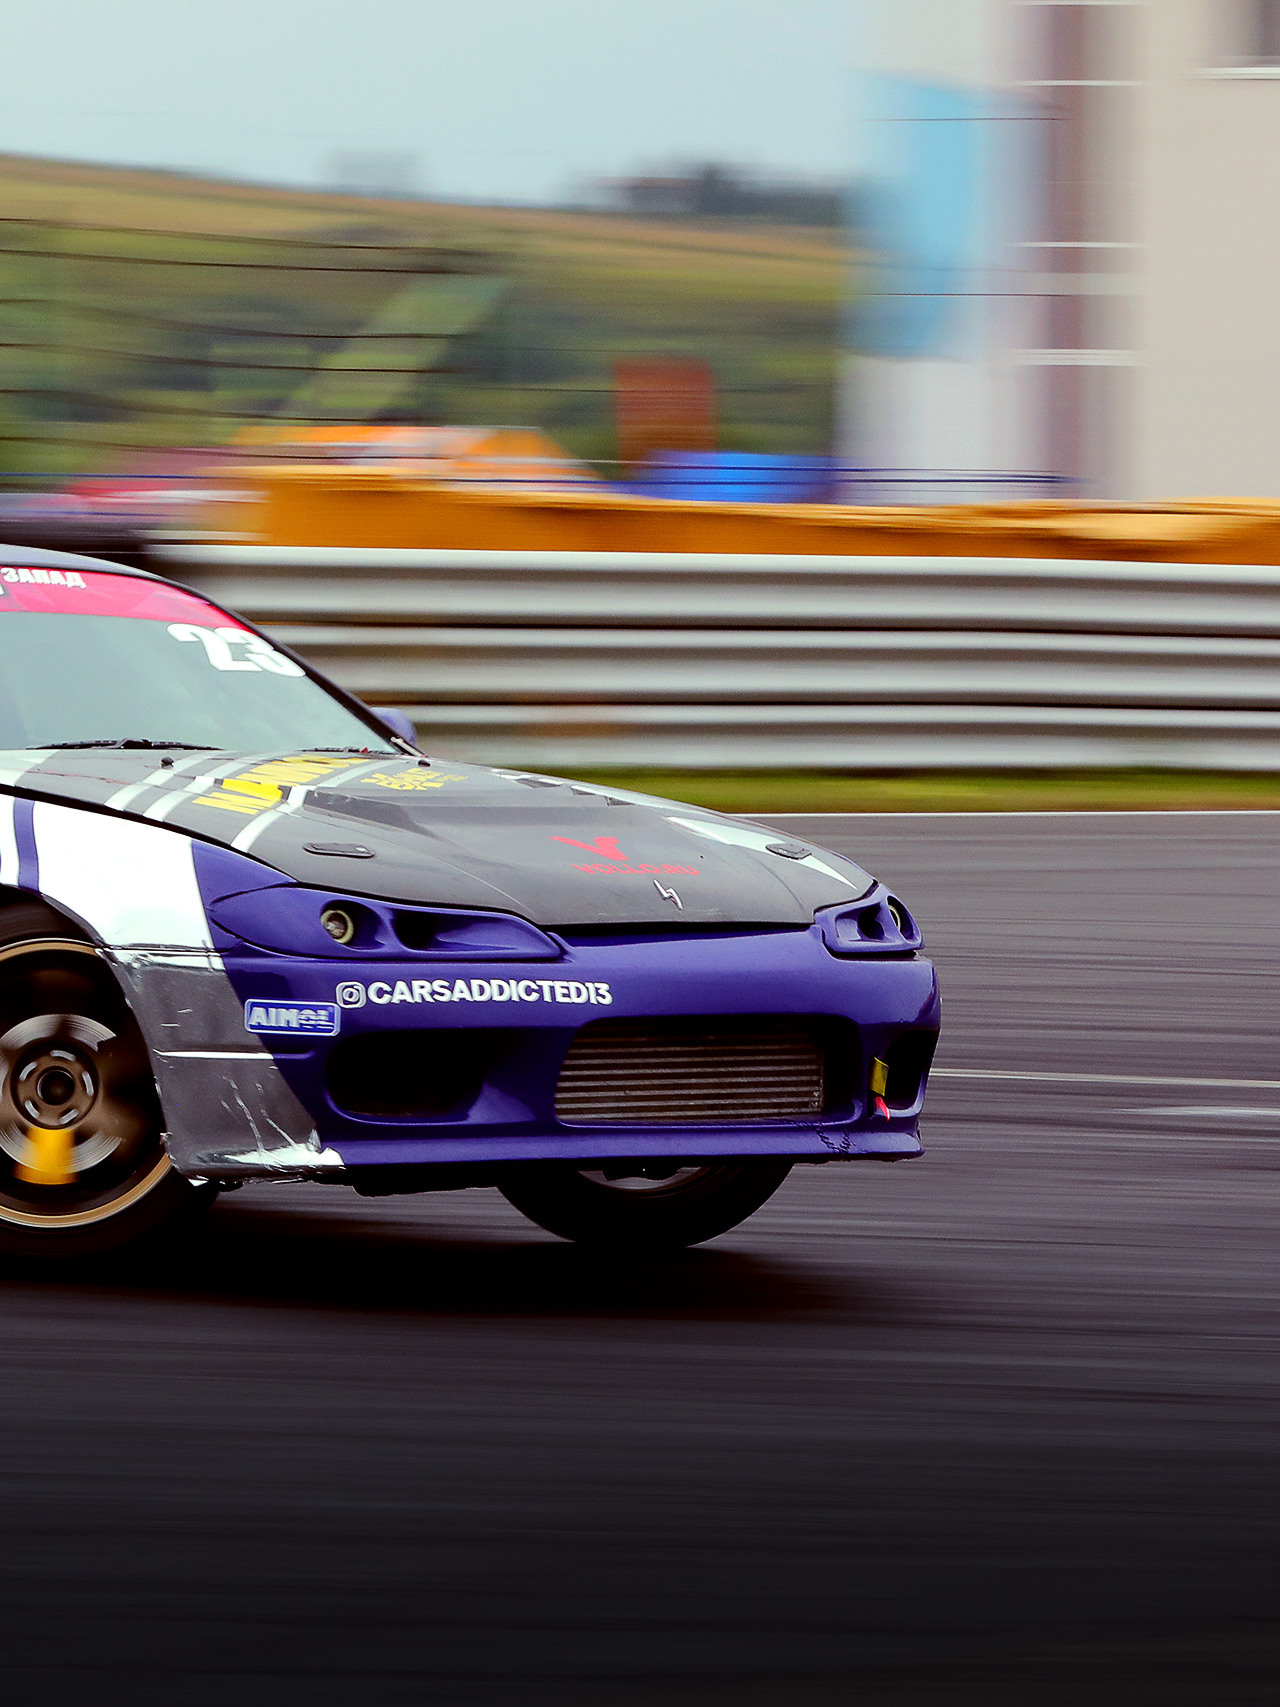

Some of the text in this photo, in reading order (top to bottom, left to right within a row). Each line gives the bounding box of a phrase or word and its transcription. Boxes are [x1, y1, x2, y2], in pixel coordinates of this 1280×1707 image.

[0, 567, 87, 589] ЗАПАД
[167, 623, 306, 677] 23
[367, 979, 613, 1005] CARSADDICTED13
[248, 1006, 335, 1029] AIMOL
